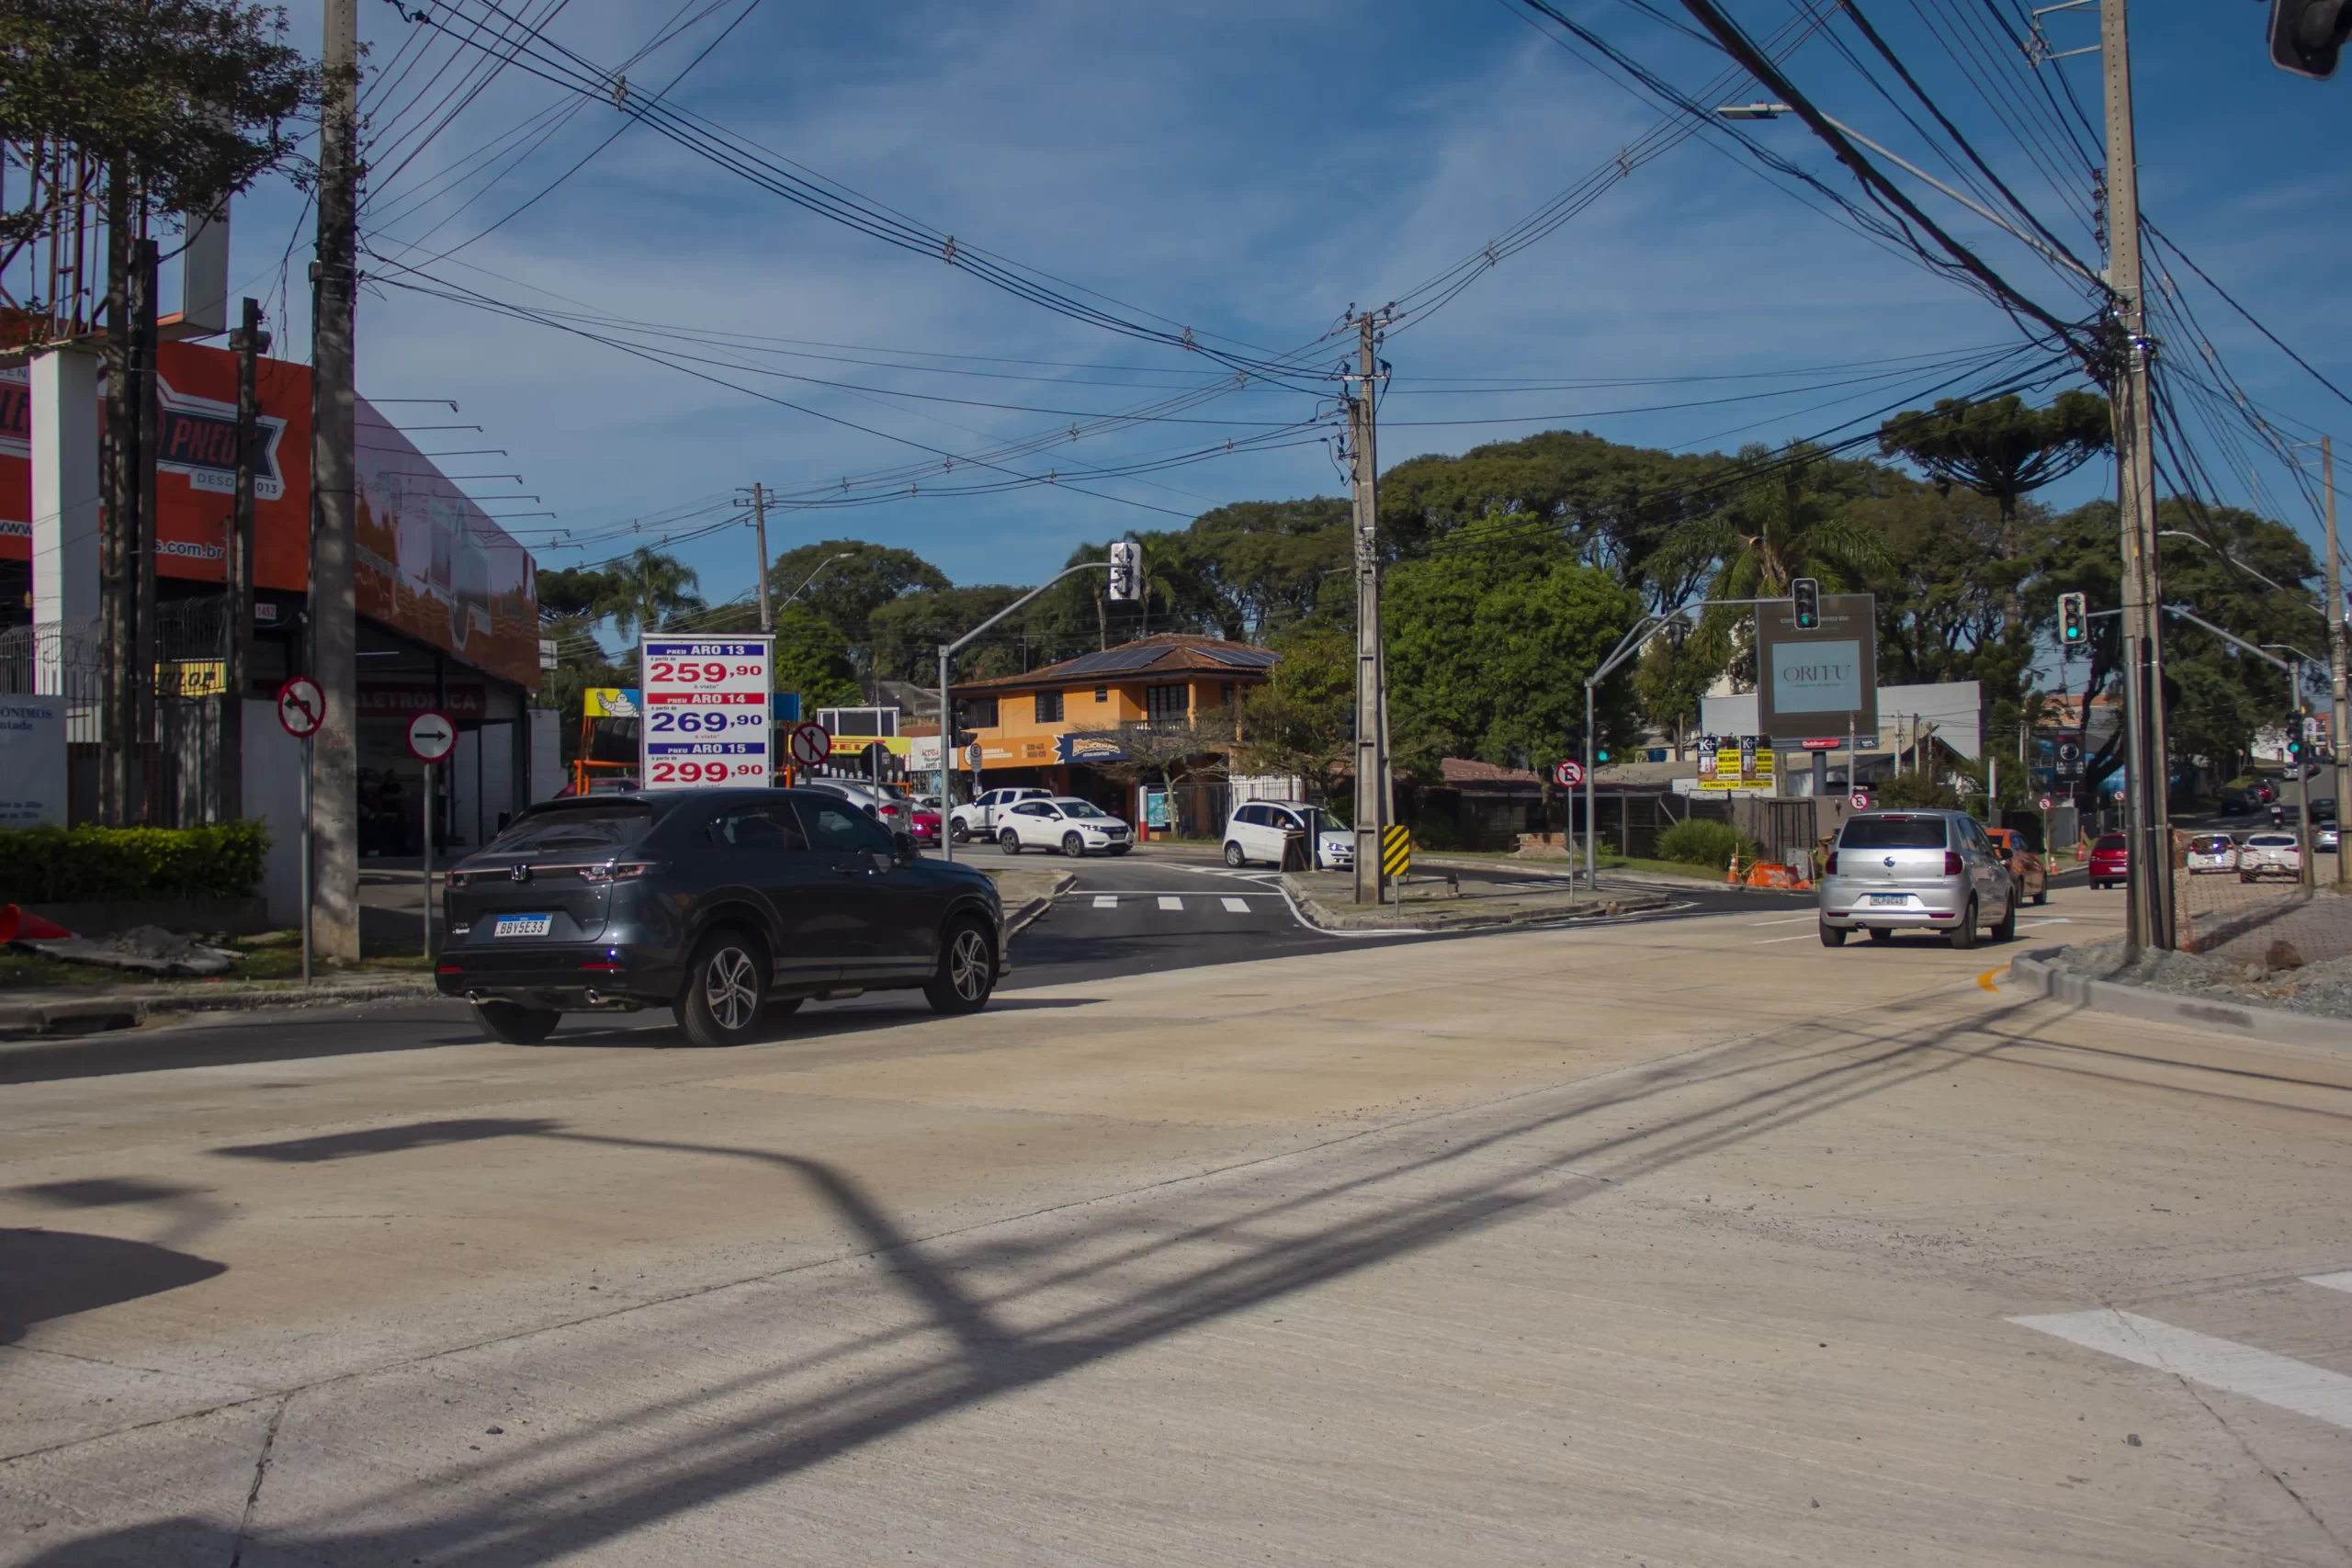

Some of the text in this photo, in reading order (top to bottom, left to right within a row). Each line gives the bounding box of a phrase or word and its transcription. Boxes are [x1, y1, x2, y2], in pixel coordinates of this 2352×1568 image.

[169, 418, 239, 465] PNEU
[197, 472, 278, 494] DESD 013
[691, 645, 722, 655] ARO
[726, 645, 745, 655] 13
[650, 662, 762, 682] 259,90
[692, 694, 723, 704] ARO
[727, 694, 746, 704] 14
[650, 712, 763, 732] 269,90
[692, 743, 723, 753] ARO
[728, 743, 746, 753] 15
[652, 761, 763, 782] 299,90
[500, 921, 545, 935] BBY5E33
